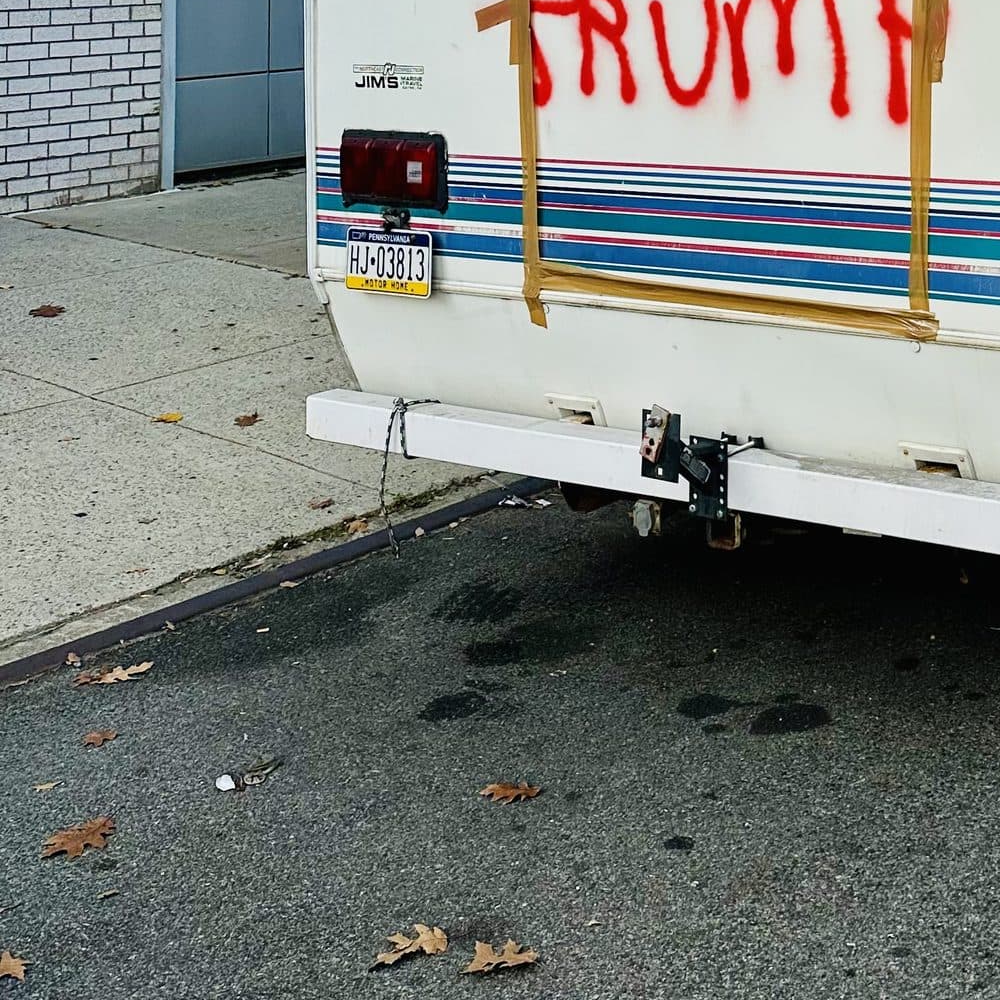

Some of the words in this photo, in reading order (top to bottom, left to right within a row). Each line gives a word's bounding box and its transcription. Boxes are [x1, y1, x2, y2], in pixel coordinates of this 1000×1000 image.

[368, 232, 411, 244] PENNSYLVANIA
[365, 279, 387, 289] MOTOR
[390, 282, 409, 291] HOME
